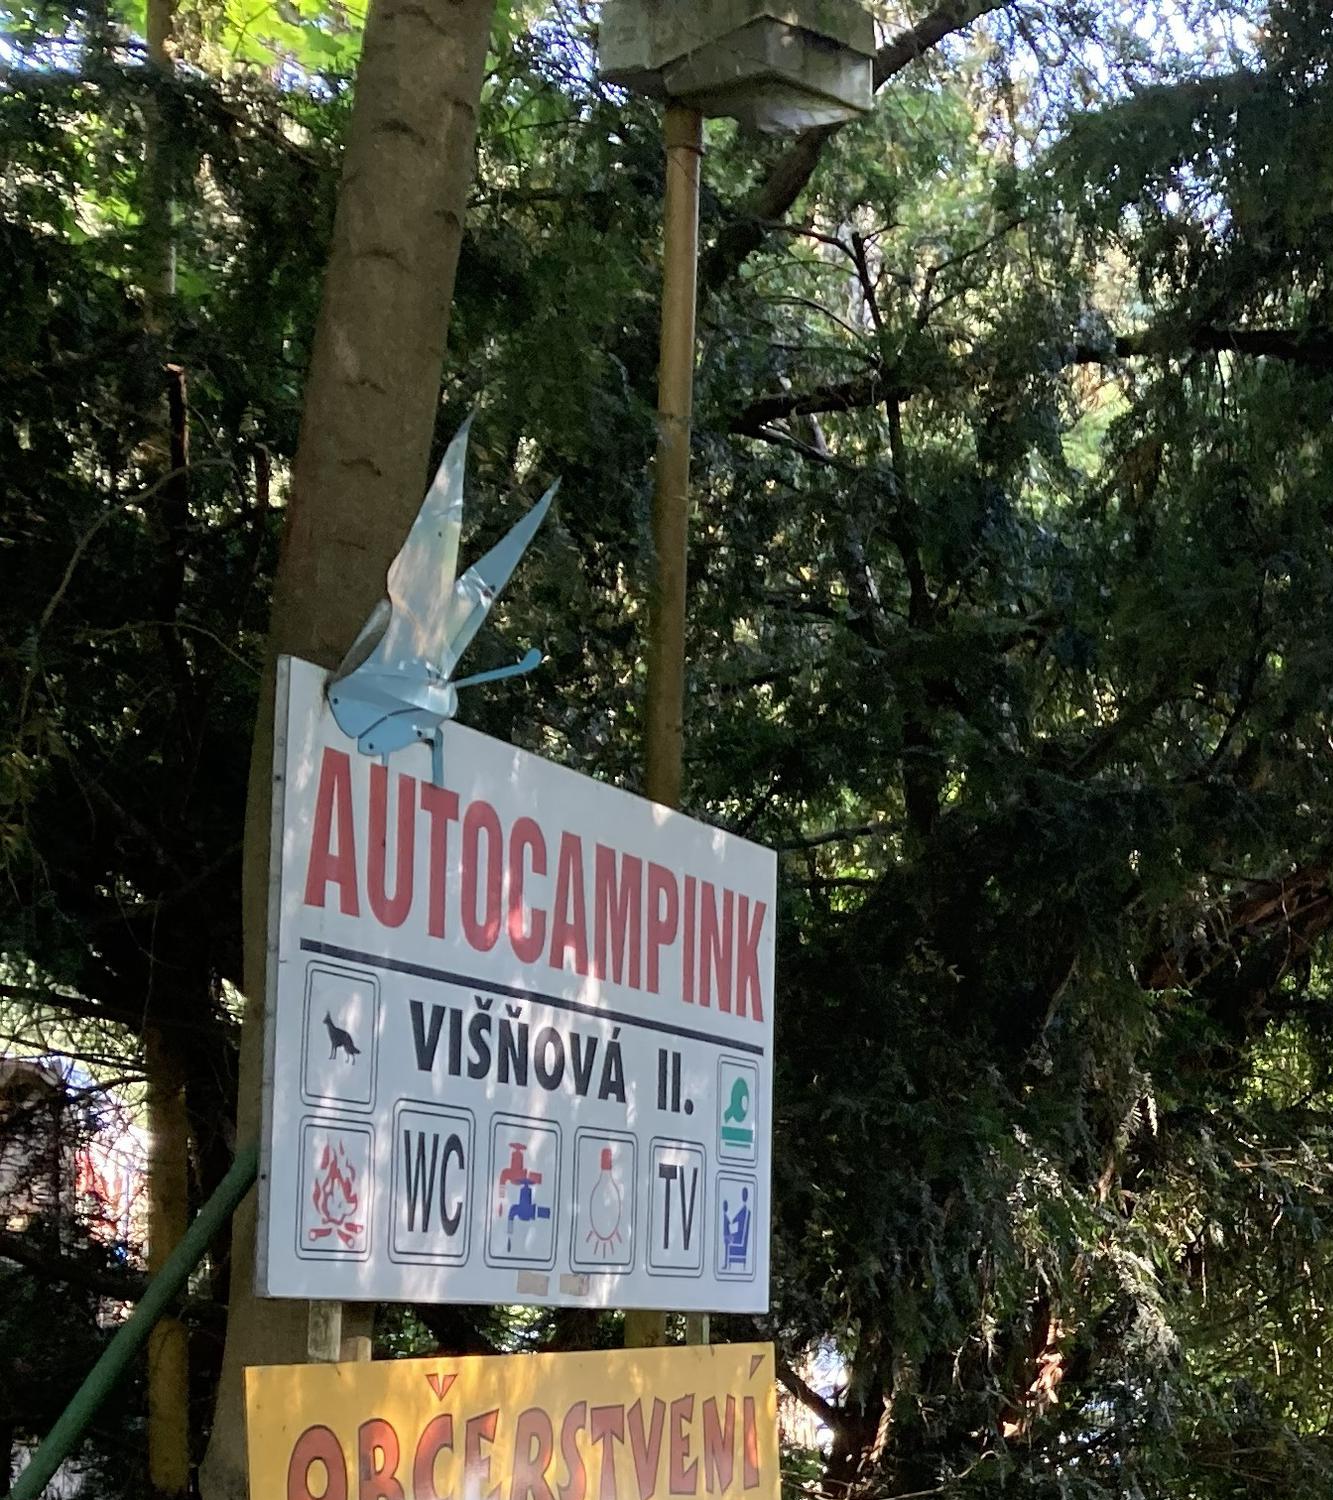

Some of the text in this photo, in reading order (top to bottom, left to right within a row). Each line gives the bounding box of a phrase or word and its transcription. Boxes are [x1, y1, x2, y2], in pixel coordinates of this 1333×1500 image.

[304, 746, 767, 1023] AUTOCAMPINK
[409, 996, 627, 1104] VIŠŇOVÁ
[403, 1129, 465, 1237] WC
[658, 1163, 698, 1251] TV
